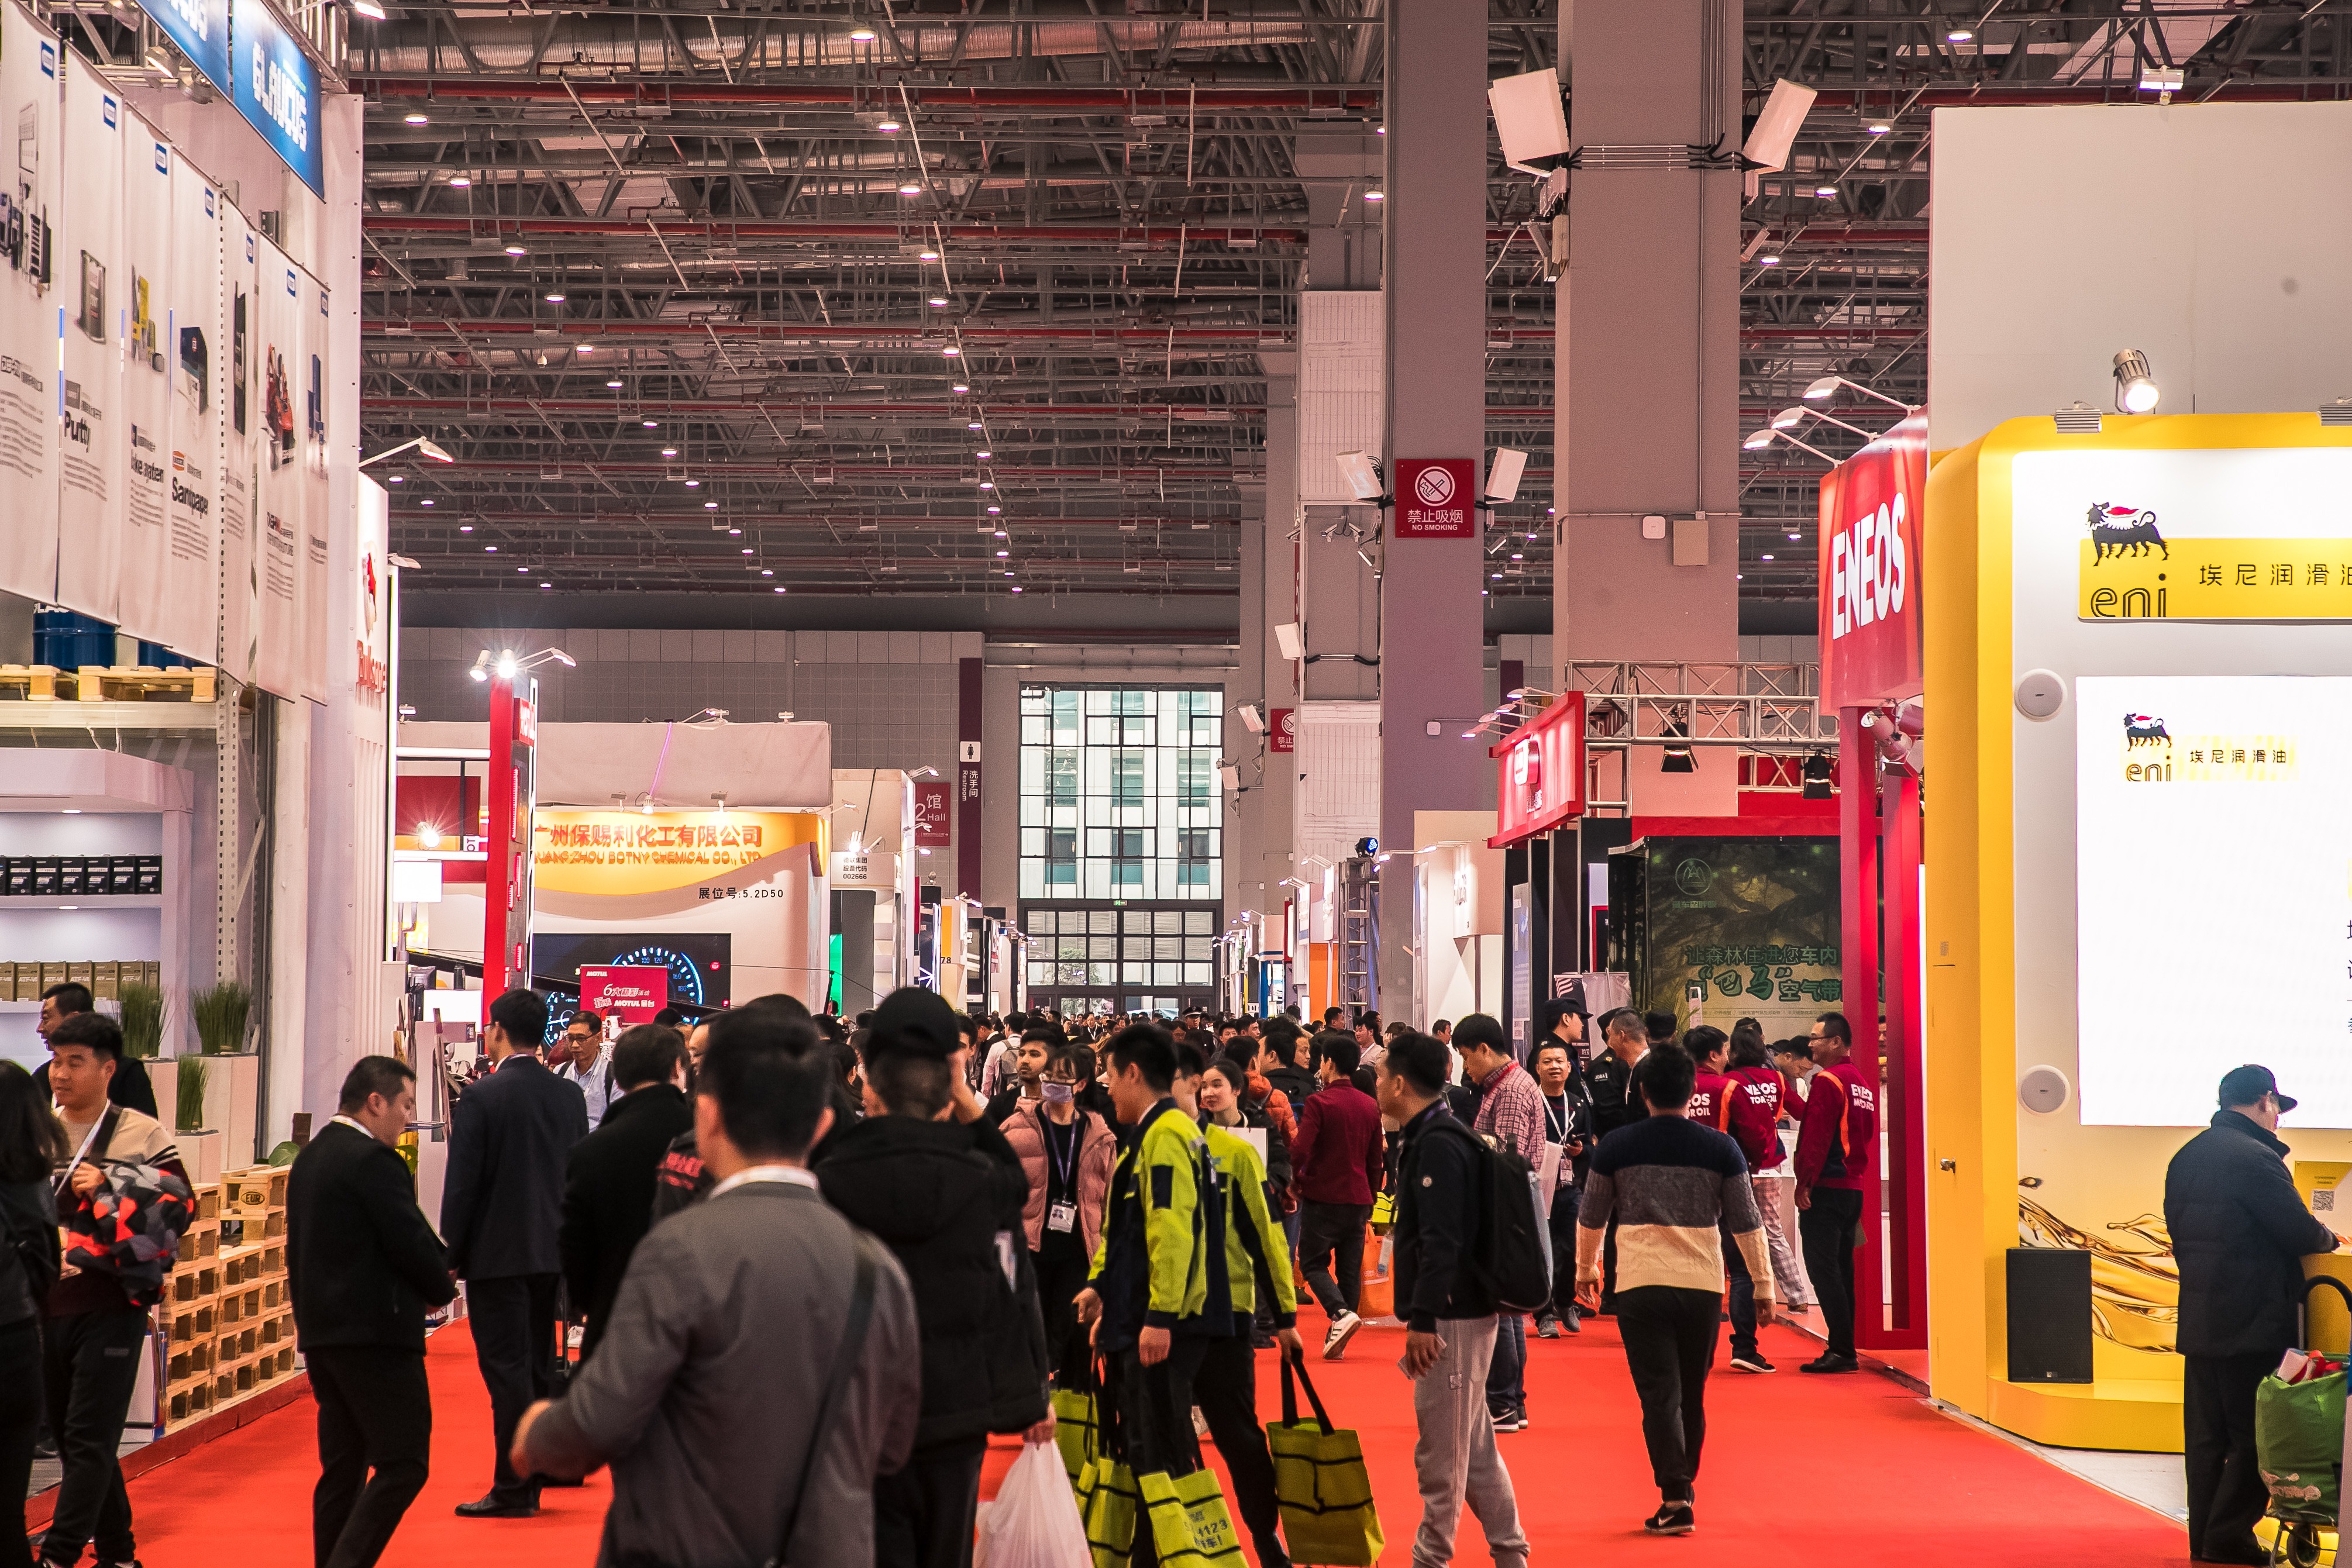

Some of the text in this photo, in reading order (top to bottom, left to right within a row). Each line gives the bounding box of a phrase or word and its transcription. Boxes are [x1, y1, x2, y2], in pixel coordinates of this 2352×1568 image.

[1407, 509, 1463, 523] 禁止吸烟
[1833, 492, 1905, 640] ENEOS
[2091, 573, 2167, 618] eni
[2190, 749, 2286, 763] 埃尼润滑油
[2126, 755, 2171, 781] eni
[969, 770, 978, 798] 洗手间
[927, 794, 942, 809] 馆
[608, 851, 650, 864] BOTNY
[652, 851, 710, 864] CHEMICAL
[1688, 946, 1838, 964] 让森林住进您车内
